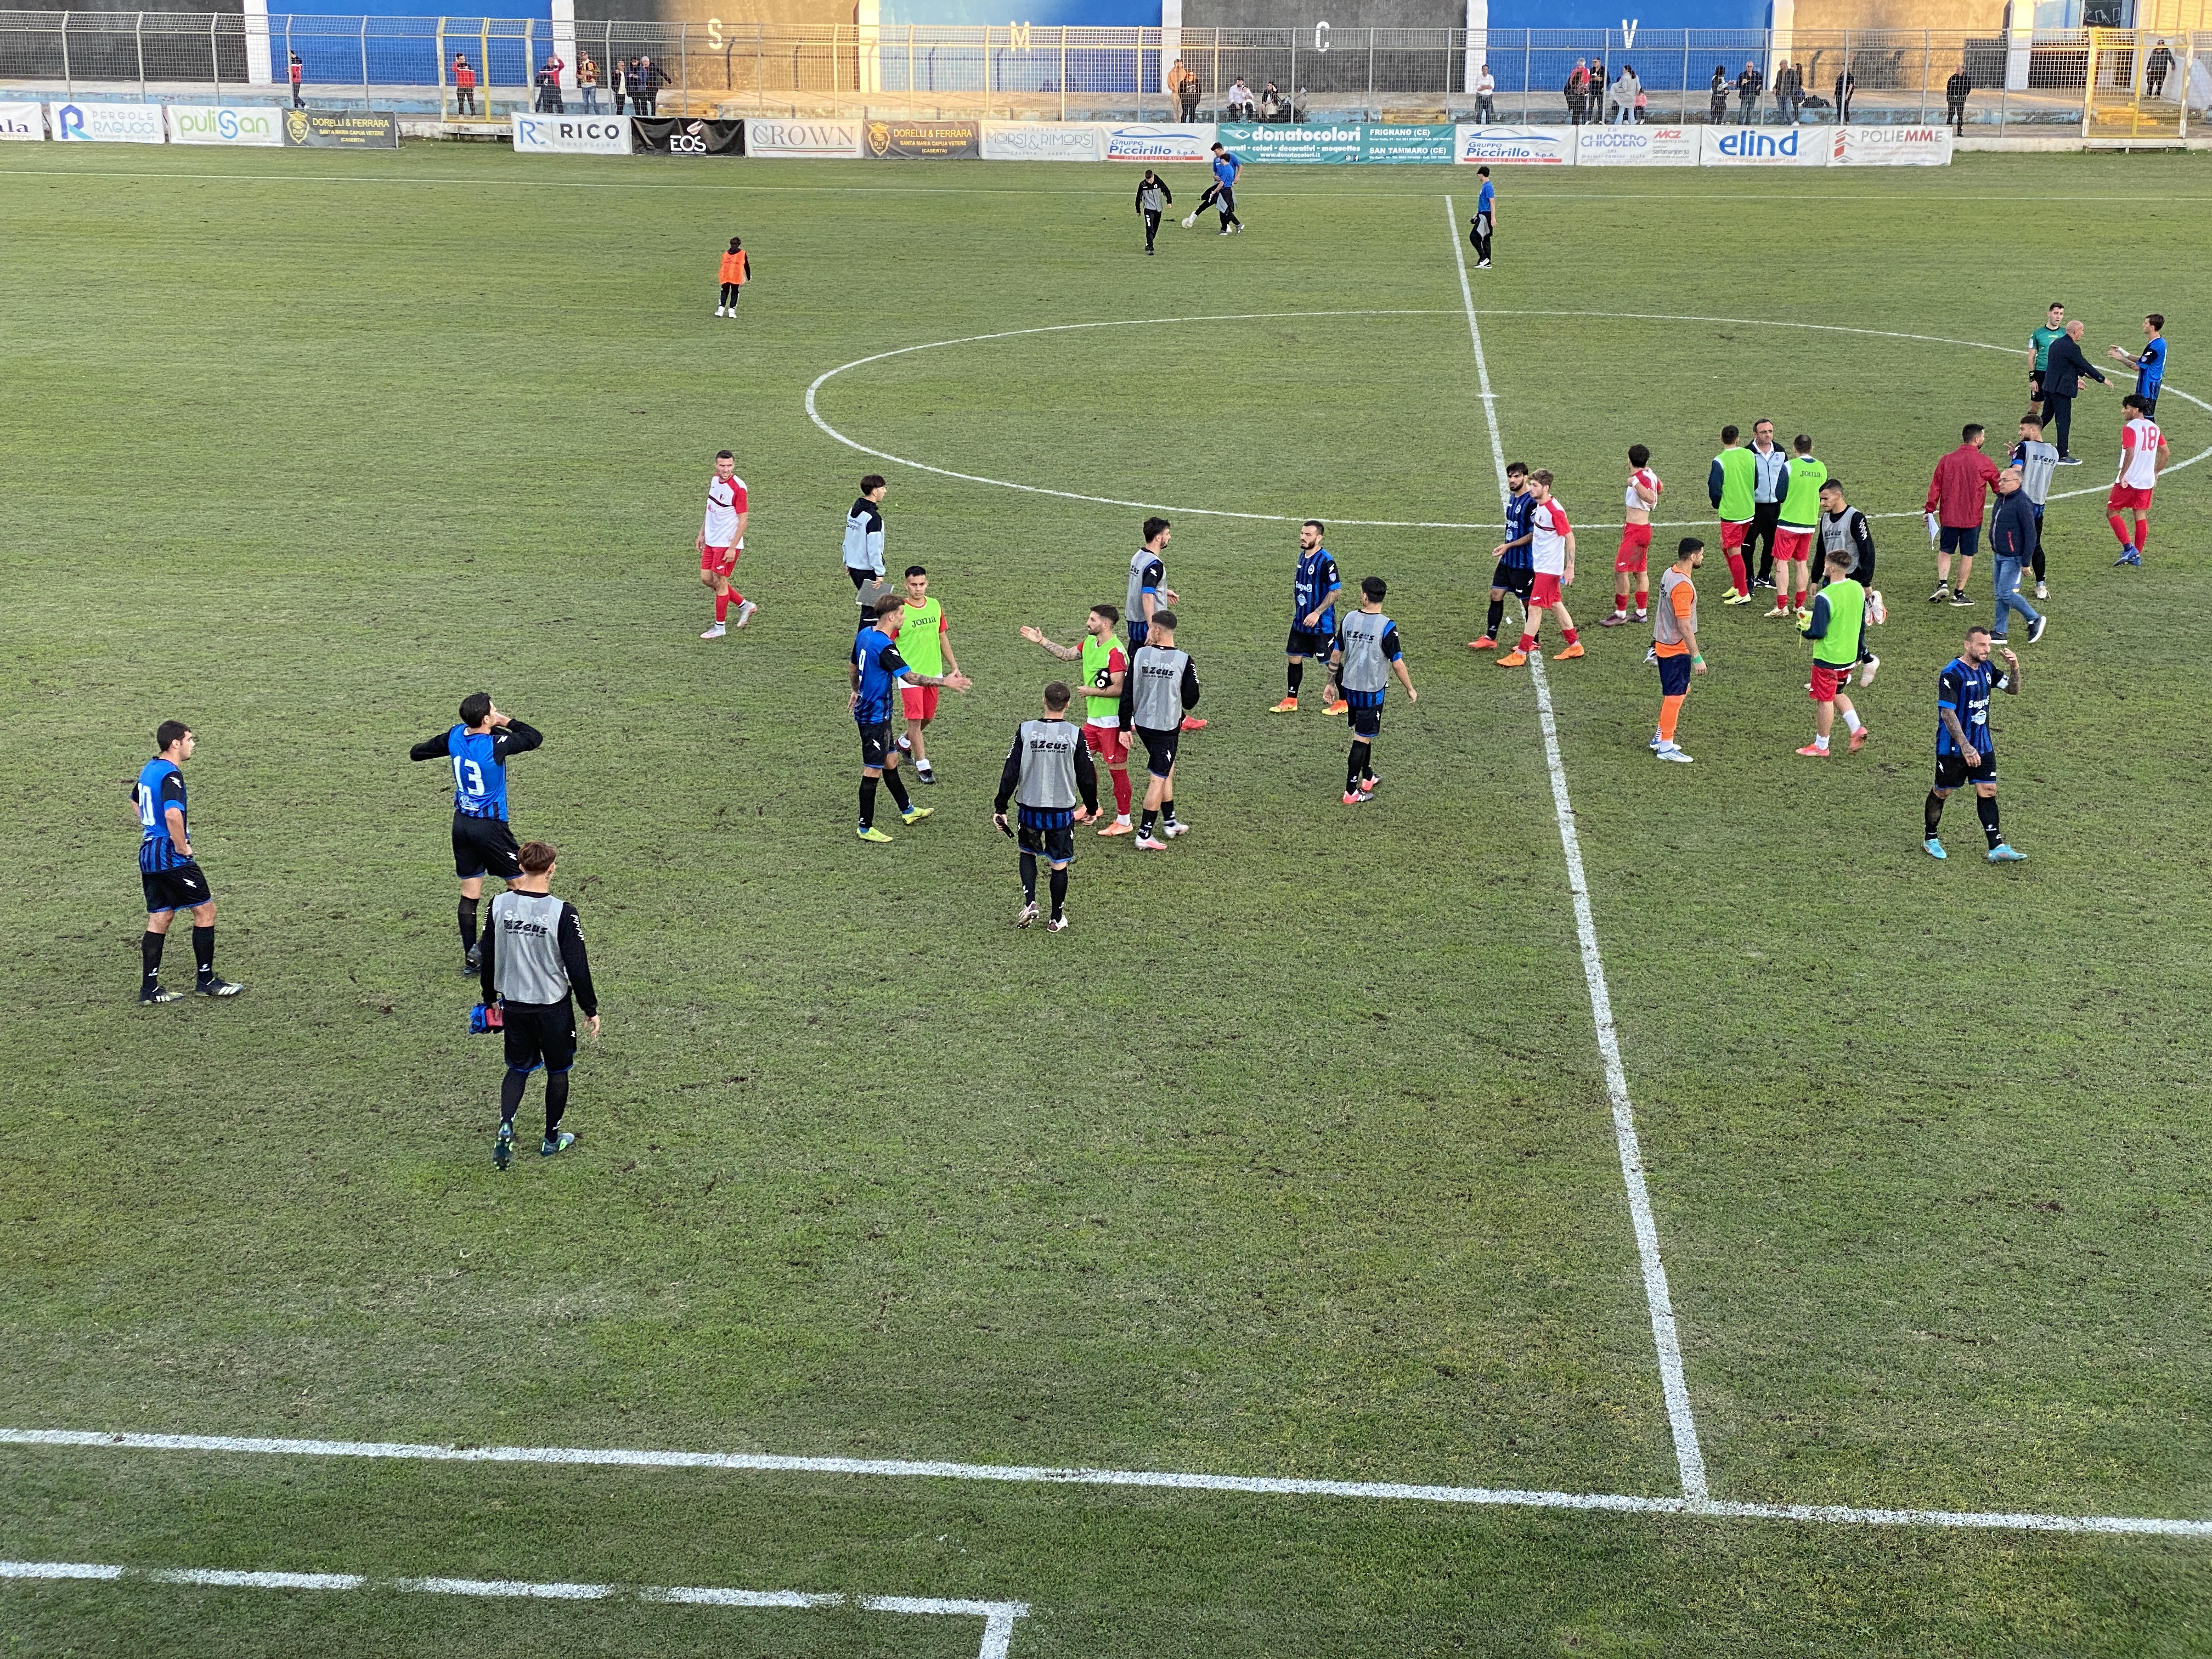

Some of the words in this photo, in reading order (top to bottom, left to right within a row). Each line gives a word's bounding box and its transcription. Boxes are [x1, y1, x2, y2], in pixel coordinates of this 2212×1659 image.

[707, 18, 723, 49] S
[1011, 21, 1030, 51] M
[1316, 21, 1330, 52] C
[1622, 19, 1638, 48] V
[92, 111, 153, 120] PERGOLE
[312, 117, 345, 127] DORELLI
[346, 119, 351, 127] &
[353, 119, 390, 128] FERRARA
[94, 121, 155, 134] RAGUCCI
[560, 123, 619, 139] RICO
[894, 129, 926, 137] DORELLI
[935, 129, 972, 138] FERRARA
[1252, 126, 1361, 141] donatocolori
[1654, 130, 1681, 139] MCZ
[753, 125, 855, 145] CROWN
[986, 132, 1027, 148] MORSI
[1028, 134, 1042, 150] &
[1041, 134, 1094, 148] RIMORSI
[1581, 134, 1647, 147] CHIODERO
[1861, 129, 1943, 143] POLIEMME
[670, 135, 707, 151] EOS
[1109, 145, 1172, 155] Piccirillo
[1719, 130, 1798, 156] elind
[1466, 148, 1530, 157] Piccirillo
[2141, 426, 2157, 451] 18
[1149, 667, 1175, 676] Zeus
[1037, 741, 1068, 750] Zeus
[453, 755, 485, 796] 13
[514, 920, 548, 934] Zeus
